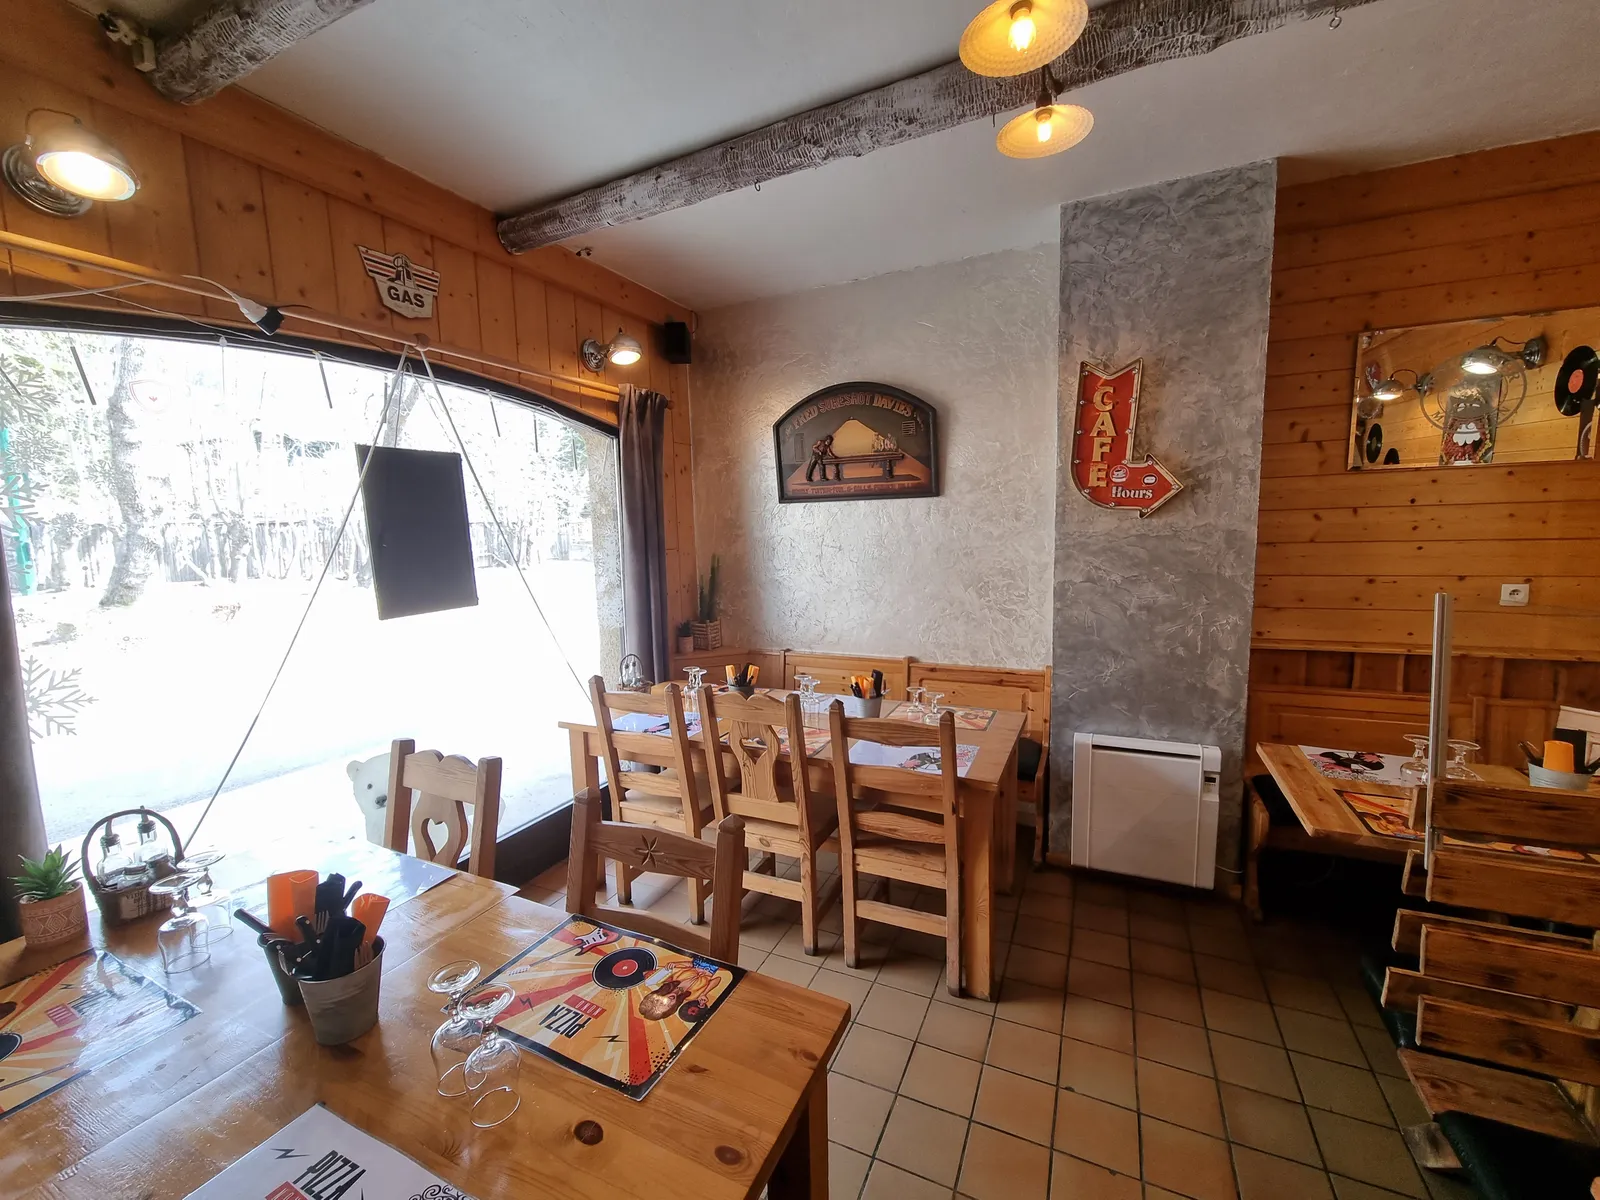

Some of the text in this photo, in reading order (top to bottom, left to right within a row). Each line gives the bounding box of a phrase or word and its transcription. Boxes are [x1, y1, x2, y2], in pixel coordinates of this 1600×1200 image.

[387, 285, 425, 309] GAS
[873, 394, 914, 417] DAVIES
[1089, 385, 1117, 488] CAFE
[1110, 486, 1153, 500] Hours
[538, 1004, 592, 1039] PIZZA
[292, 1149, 367, 1200] PIZZA
